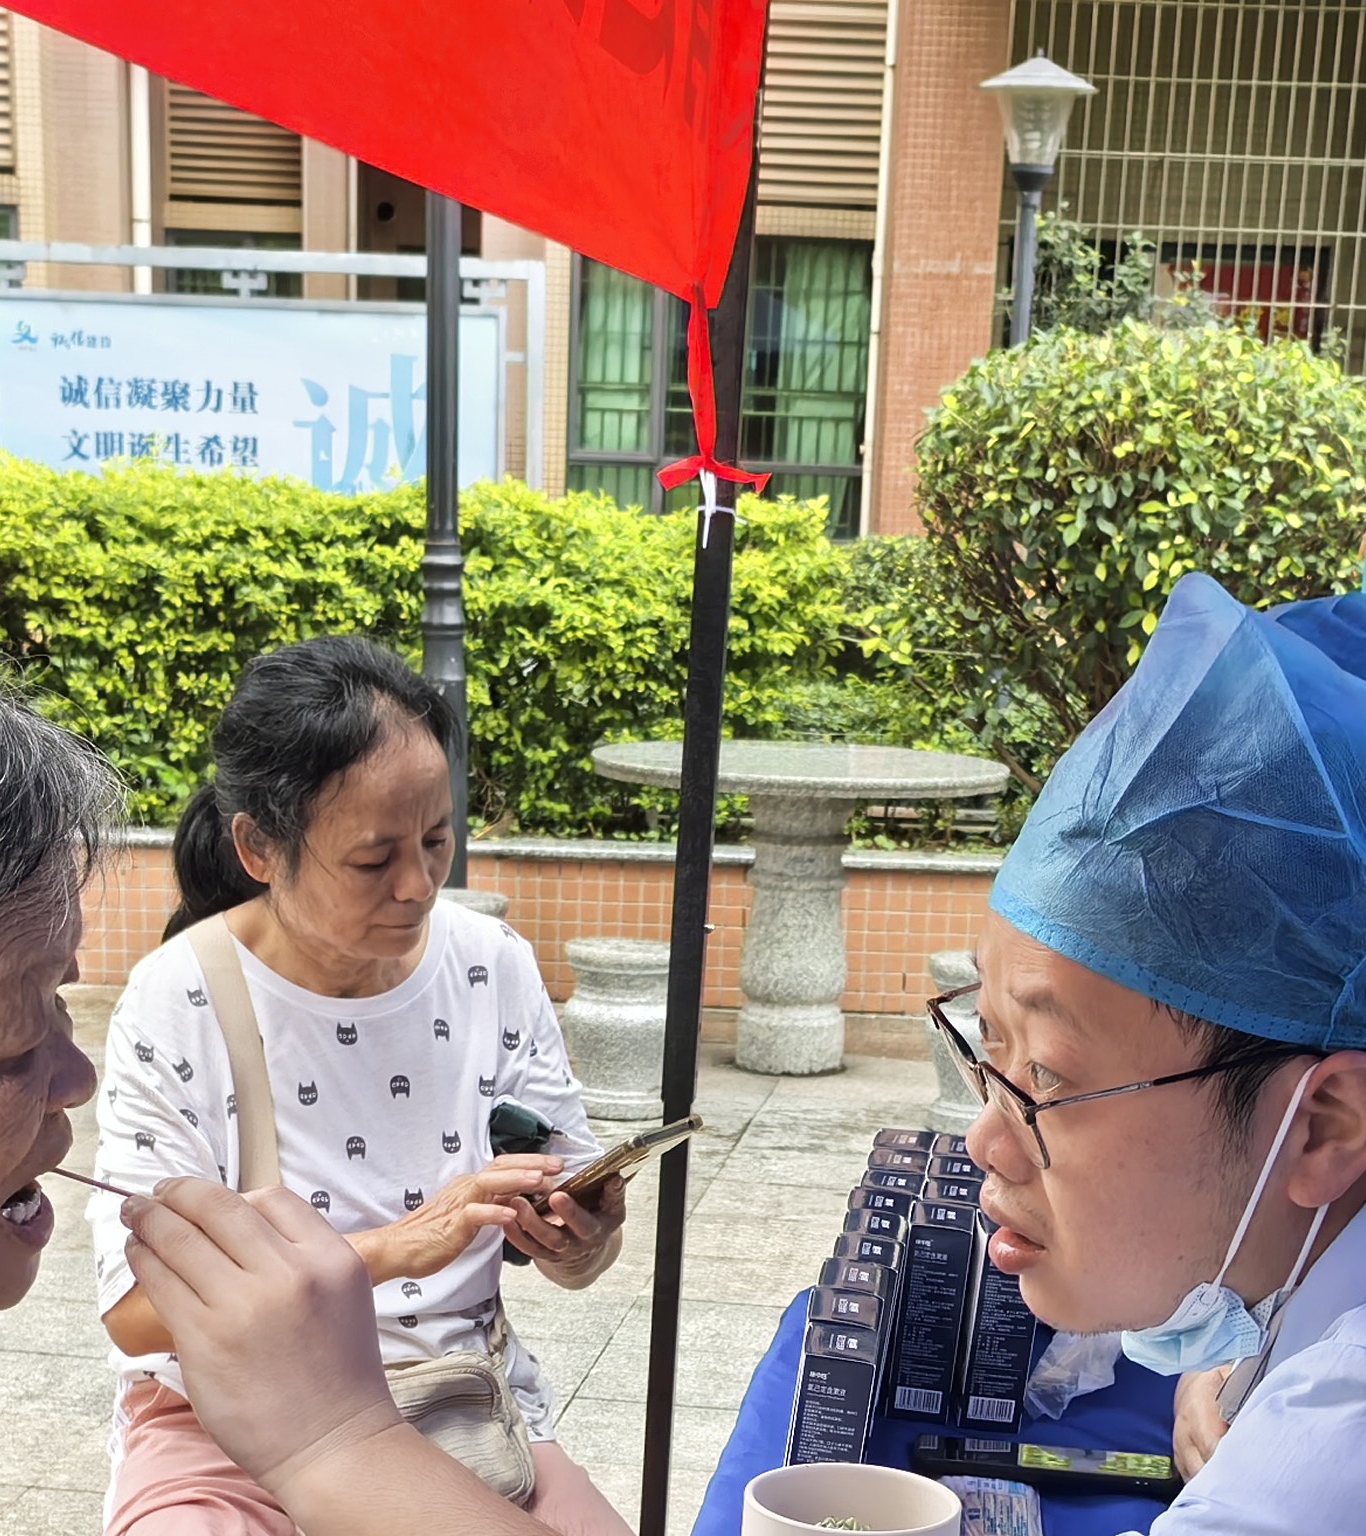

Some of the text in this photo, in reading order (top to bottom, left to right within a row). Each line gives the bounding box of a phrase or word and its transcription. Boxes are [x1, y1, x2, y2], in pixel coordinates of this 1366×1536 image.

[59, 376, 260, 416] 诚信凝聚力量
[61, 430, 260, 468] 文明诞生希望
